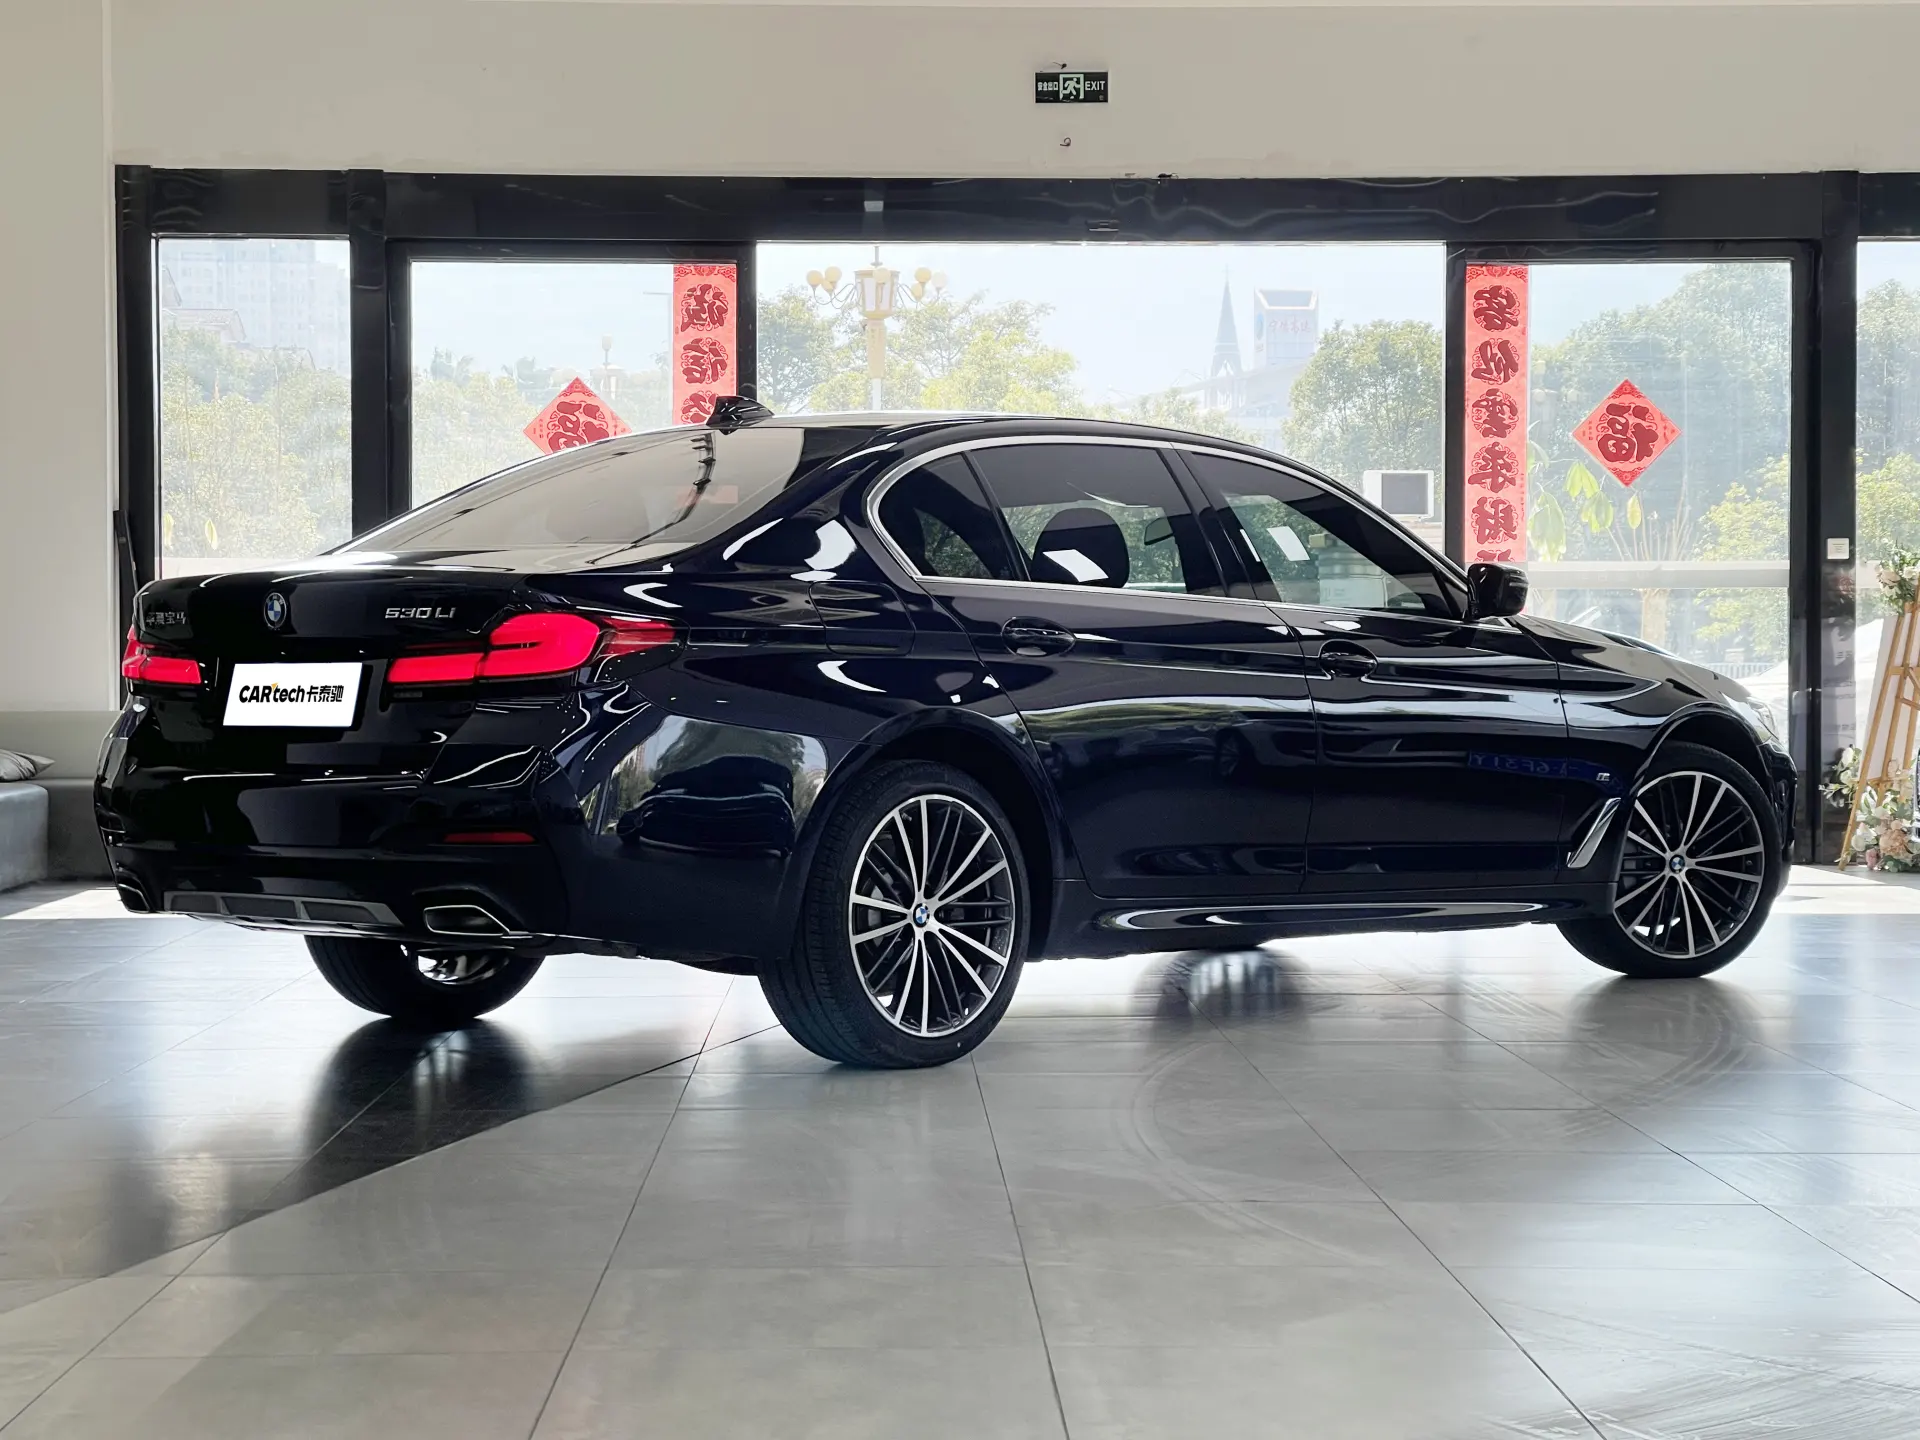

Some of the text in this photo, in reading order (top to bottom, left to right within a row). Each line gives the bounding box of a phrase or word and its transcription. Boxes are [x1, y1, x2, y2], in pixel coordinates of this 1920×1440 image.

[1085, 81, 1106, 91] EXIT
[306, 685, 344, 703] 卡泰驰
